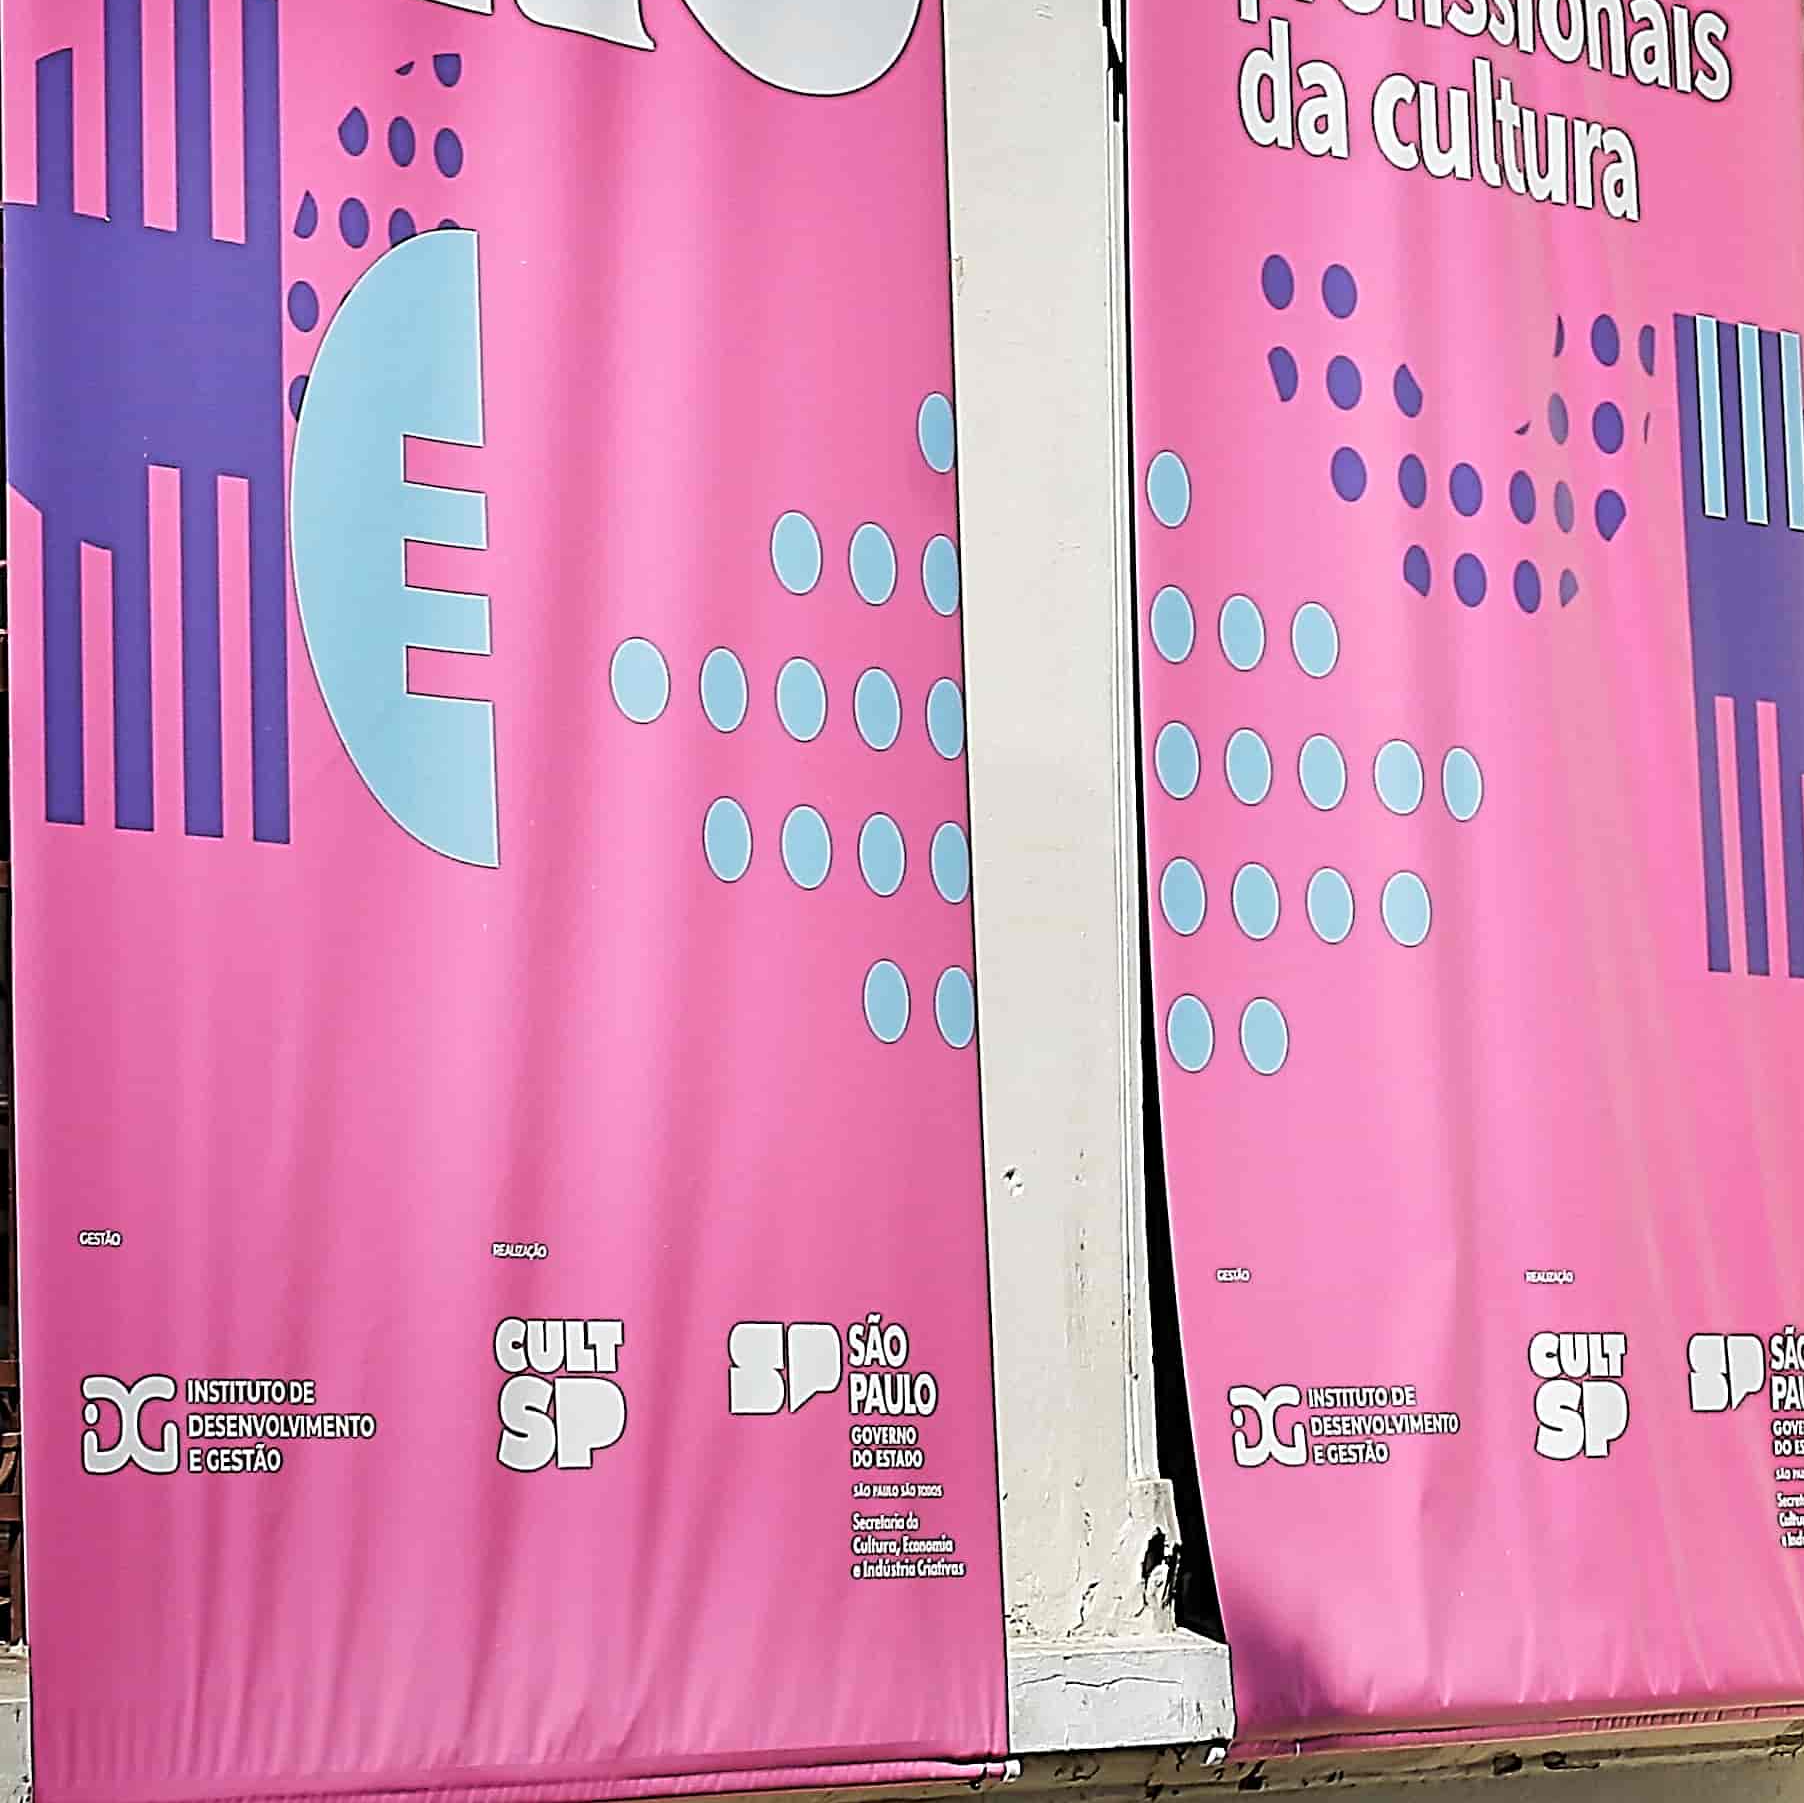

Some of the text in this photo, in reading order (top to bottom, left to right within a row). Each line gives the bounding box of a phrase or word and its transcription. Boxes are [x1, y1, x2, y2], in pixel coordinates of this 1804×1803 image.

[1238, 17, 1641, 222] da cultura
[78, 1229, 122, 1247] GESTÃO
[494, 1316, 625, 1374] CULT
[848, 1312, 909, 1368] SÃO
[1528, 1331, 1628, 1380] CULT
[186, 1379, 316, 1405] INSTITUTO DE
[848, 1371, 938, 1416] PAULO
[1308, 1385, 1417, 1409] INSTITUTO DE
[187, 1413, 376, 1438] DESENVOLVIMENTO
[497, 1373, 628, 1472] SP
[1310, 1413, 1460, 1437] DESENVOLVIMENTO
[1534, 1378, 1630, 1460] SP
[850, 1424, 919, 1446] GOVERNO
[1773, 1439, 1793, 1456] DO
[188, 1443, 282, 1473] E GESTÃO
[850, 1448, 924, 1469] DO ESTADO
[1313, 1439, 1390, 1465] E GESTÃO
[852, 1512, 904, 1531] Secretaria
[852, 1533, 955, 1556] Cultura, Economia
[852, 1557, 966, 1579] e Indústria Criativas
